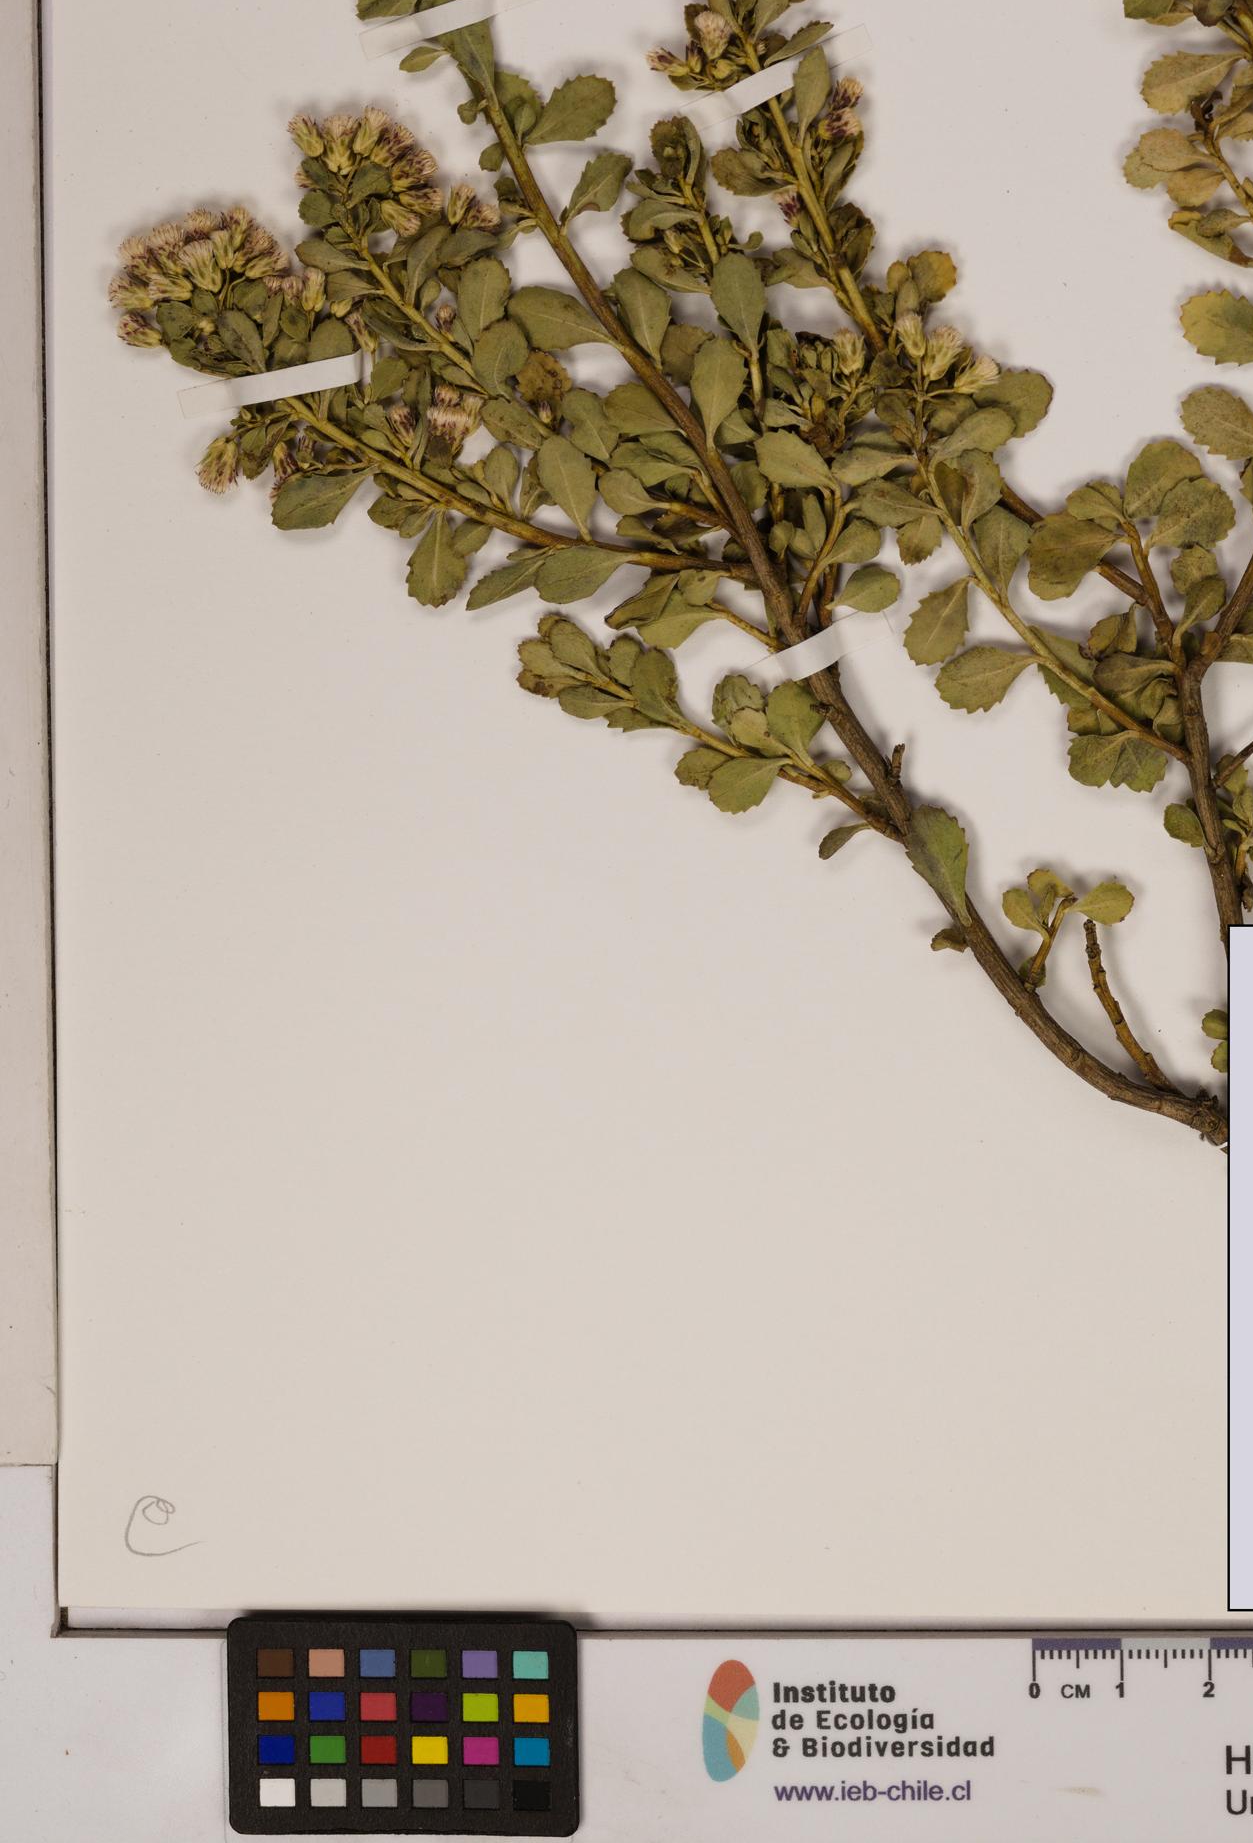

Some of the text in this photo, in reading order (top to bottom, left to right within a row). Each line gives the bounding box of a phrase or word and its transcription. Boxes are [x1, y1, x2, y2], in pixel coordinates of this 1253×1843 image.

[772, 1679, 897, 1704] Instituto
[1028, 1682, 1041, 1699] 0
[1060, 1684, 1091, 1699] CM
[1115, 1681, 1126, 1698] 1
[1202, 1681, 1215, 1698] 2
[771, 1707, 935, 1734] de Ecología
[771, 1735, 995, 1758] & Biodiversidad
[773, 1779, 972, 1802] www.ieb-chile.cl
